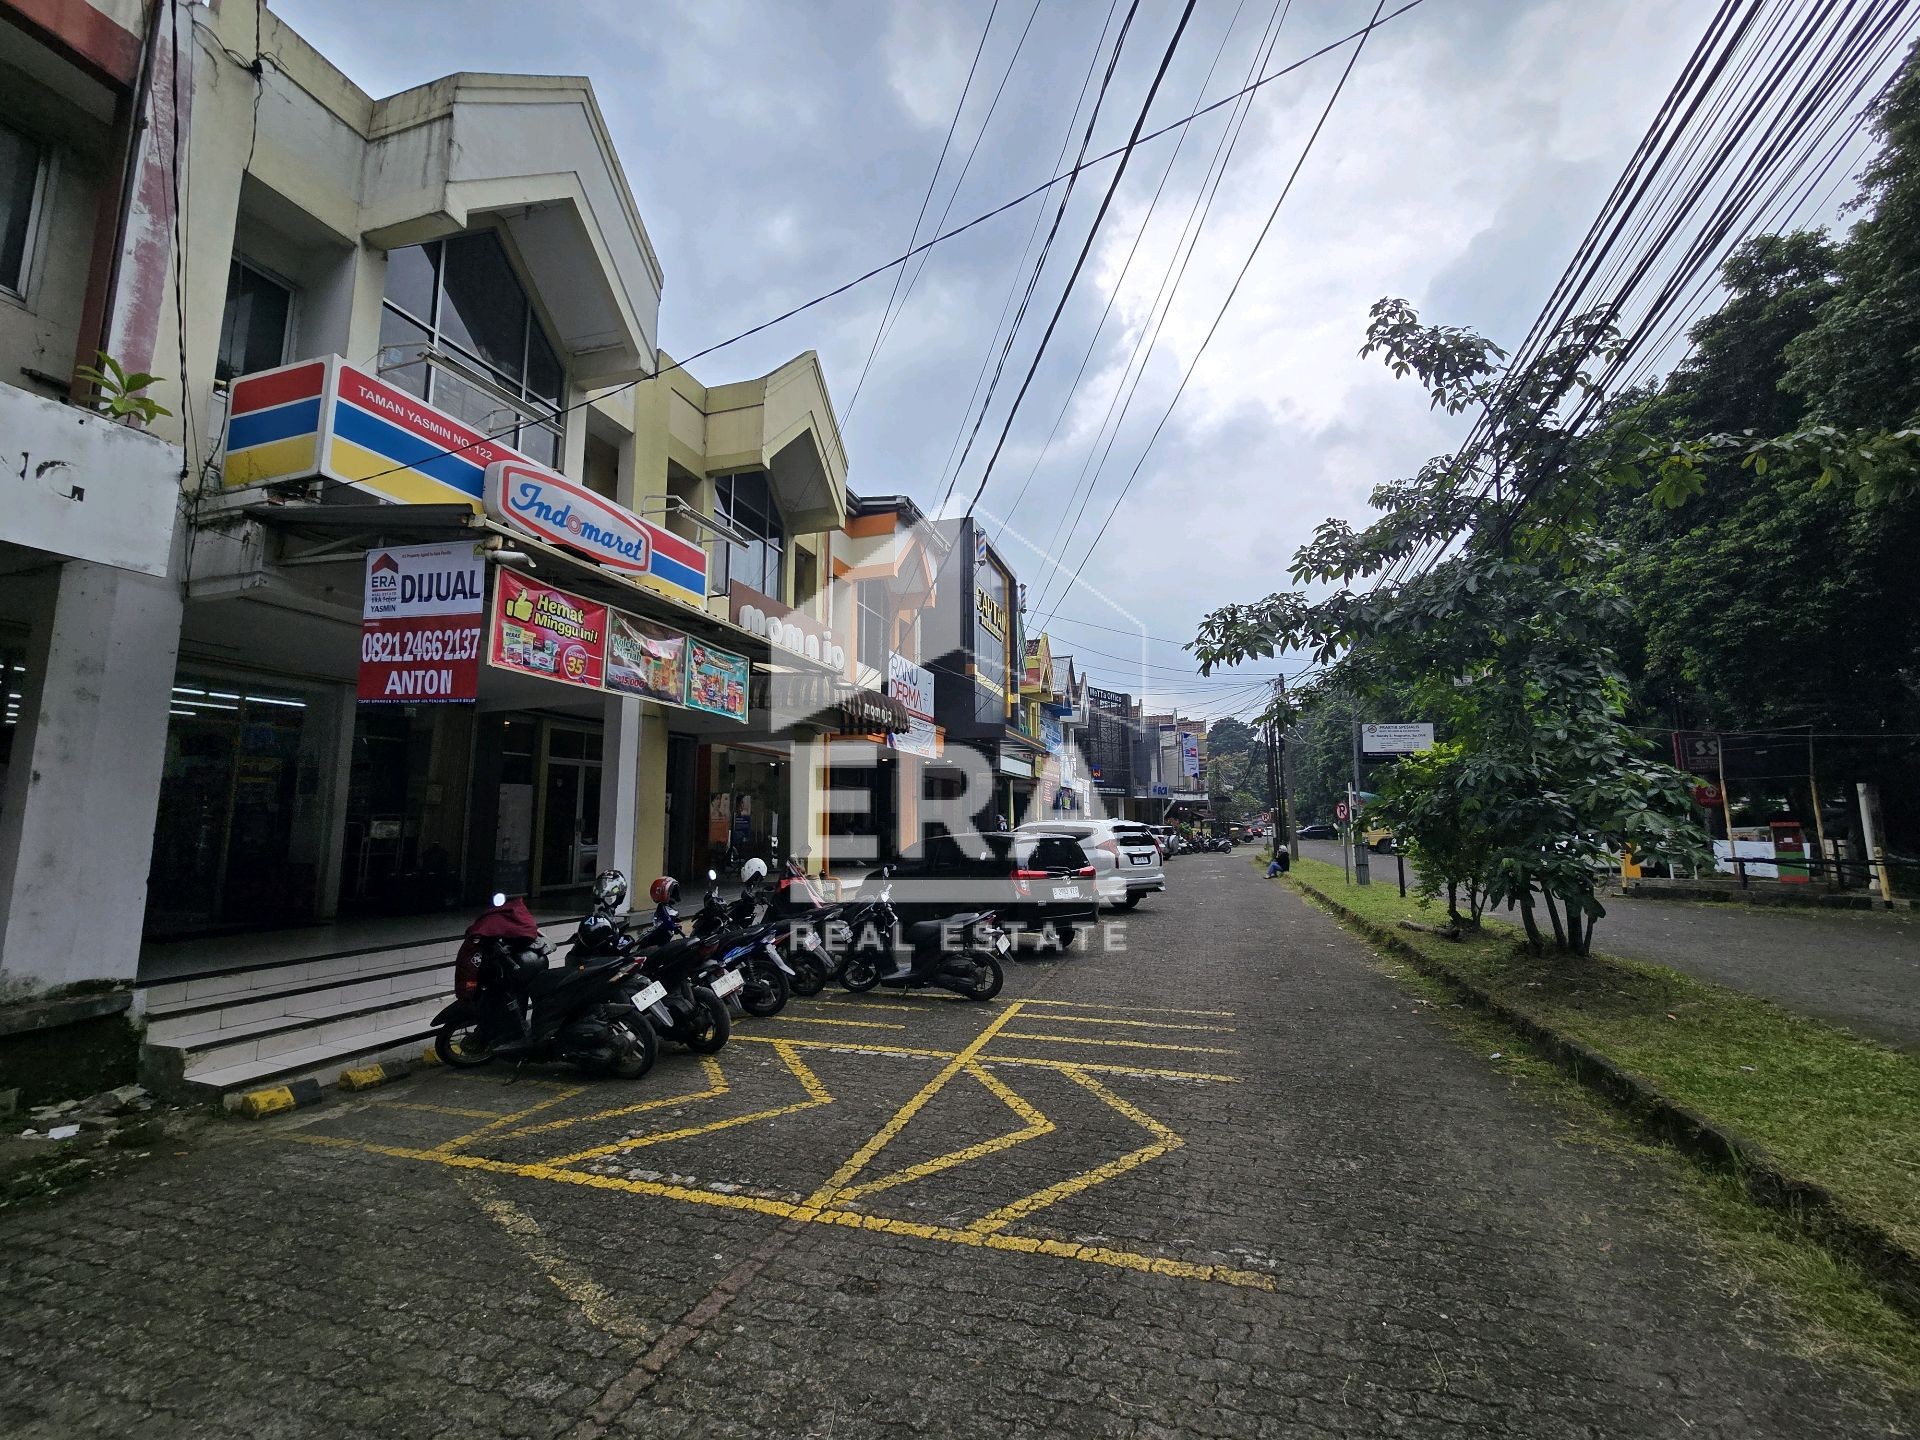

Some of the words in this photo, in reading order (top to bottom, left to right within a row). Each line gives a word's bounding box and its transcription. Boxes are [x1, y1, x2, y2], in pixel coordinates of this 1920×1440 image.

[358, 385, 404, 417] TAMAN
[407, 410, 451, 440] YASMIN
[475, 445, 493, 461] 122
[510, 482, 643, 561] Indomaret
[371, 575, 397, 588] ERA
[400, 569, 481, 604] DIJUAL
[370, 604, 396, 613] YASMIN
[537, 593, 584, 624] Hemat
[534, 612, 580, 638] Minggu
[580, 626, 598, 644] Ini!
[612, 633, 641, 652] Koleksi
[361, 631, 403, 663] 0821
[403, 629, 443, 662] 2466
[443, 627, 481, 661] 2137
[613, 646, 642, 664] Meriah
[567, 656, 584, 674] 35
[891, 656, 919, 687] RANU
[384, 669, 453, 695] ANTON
[890, 678, 923, 712] DERMA
[1157, 786, 1168, 796] BCA
